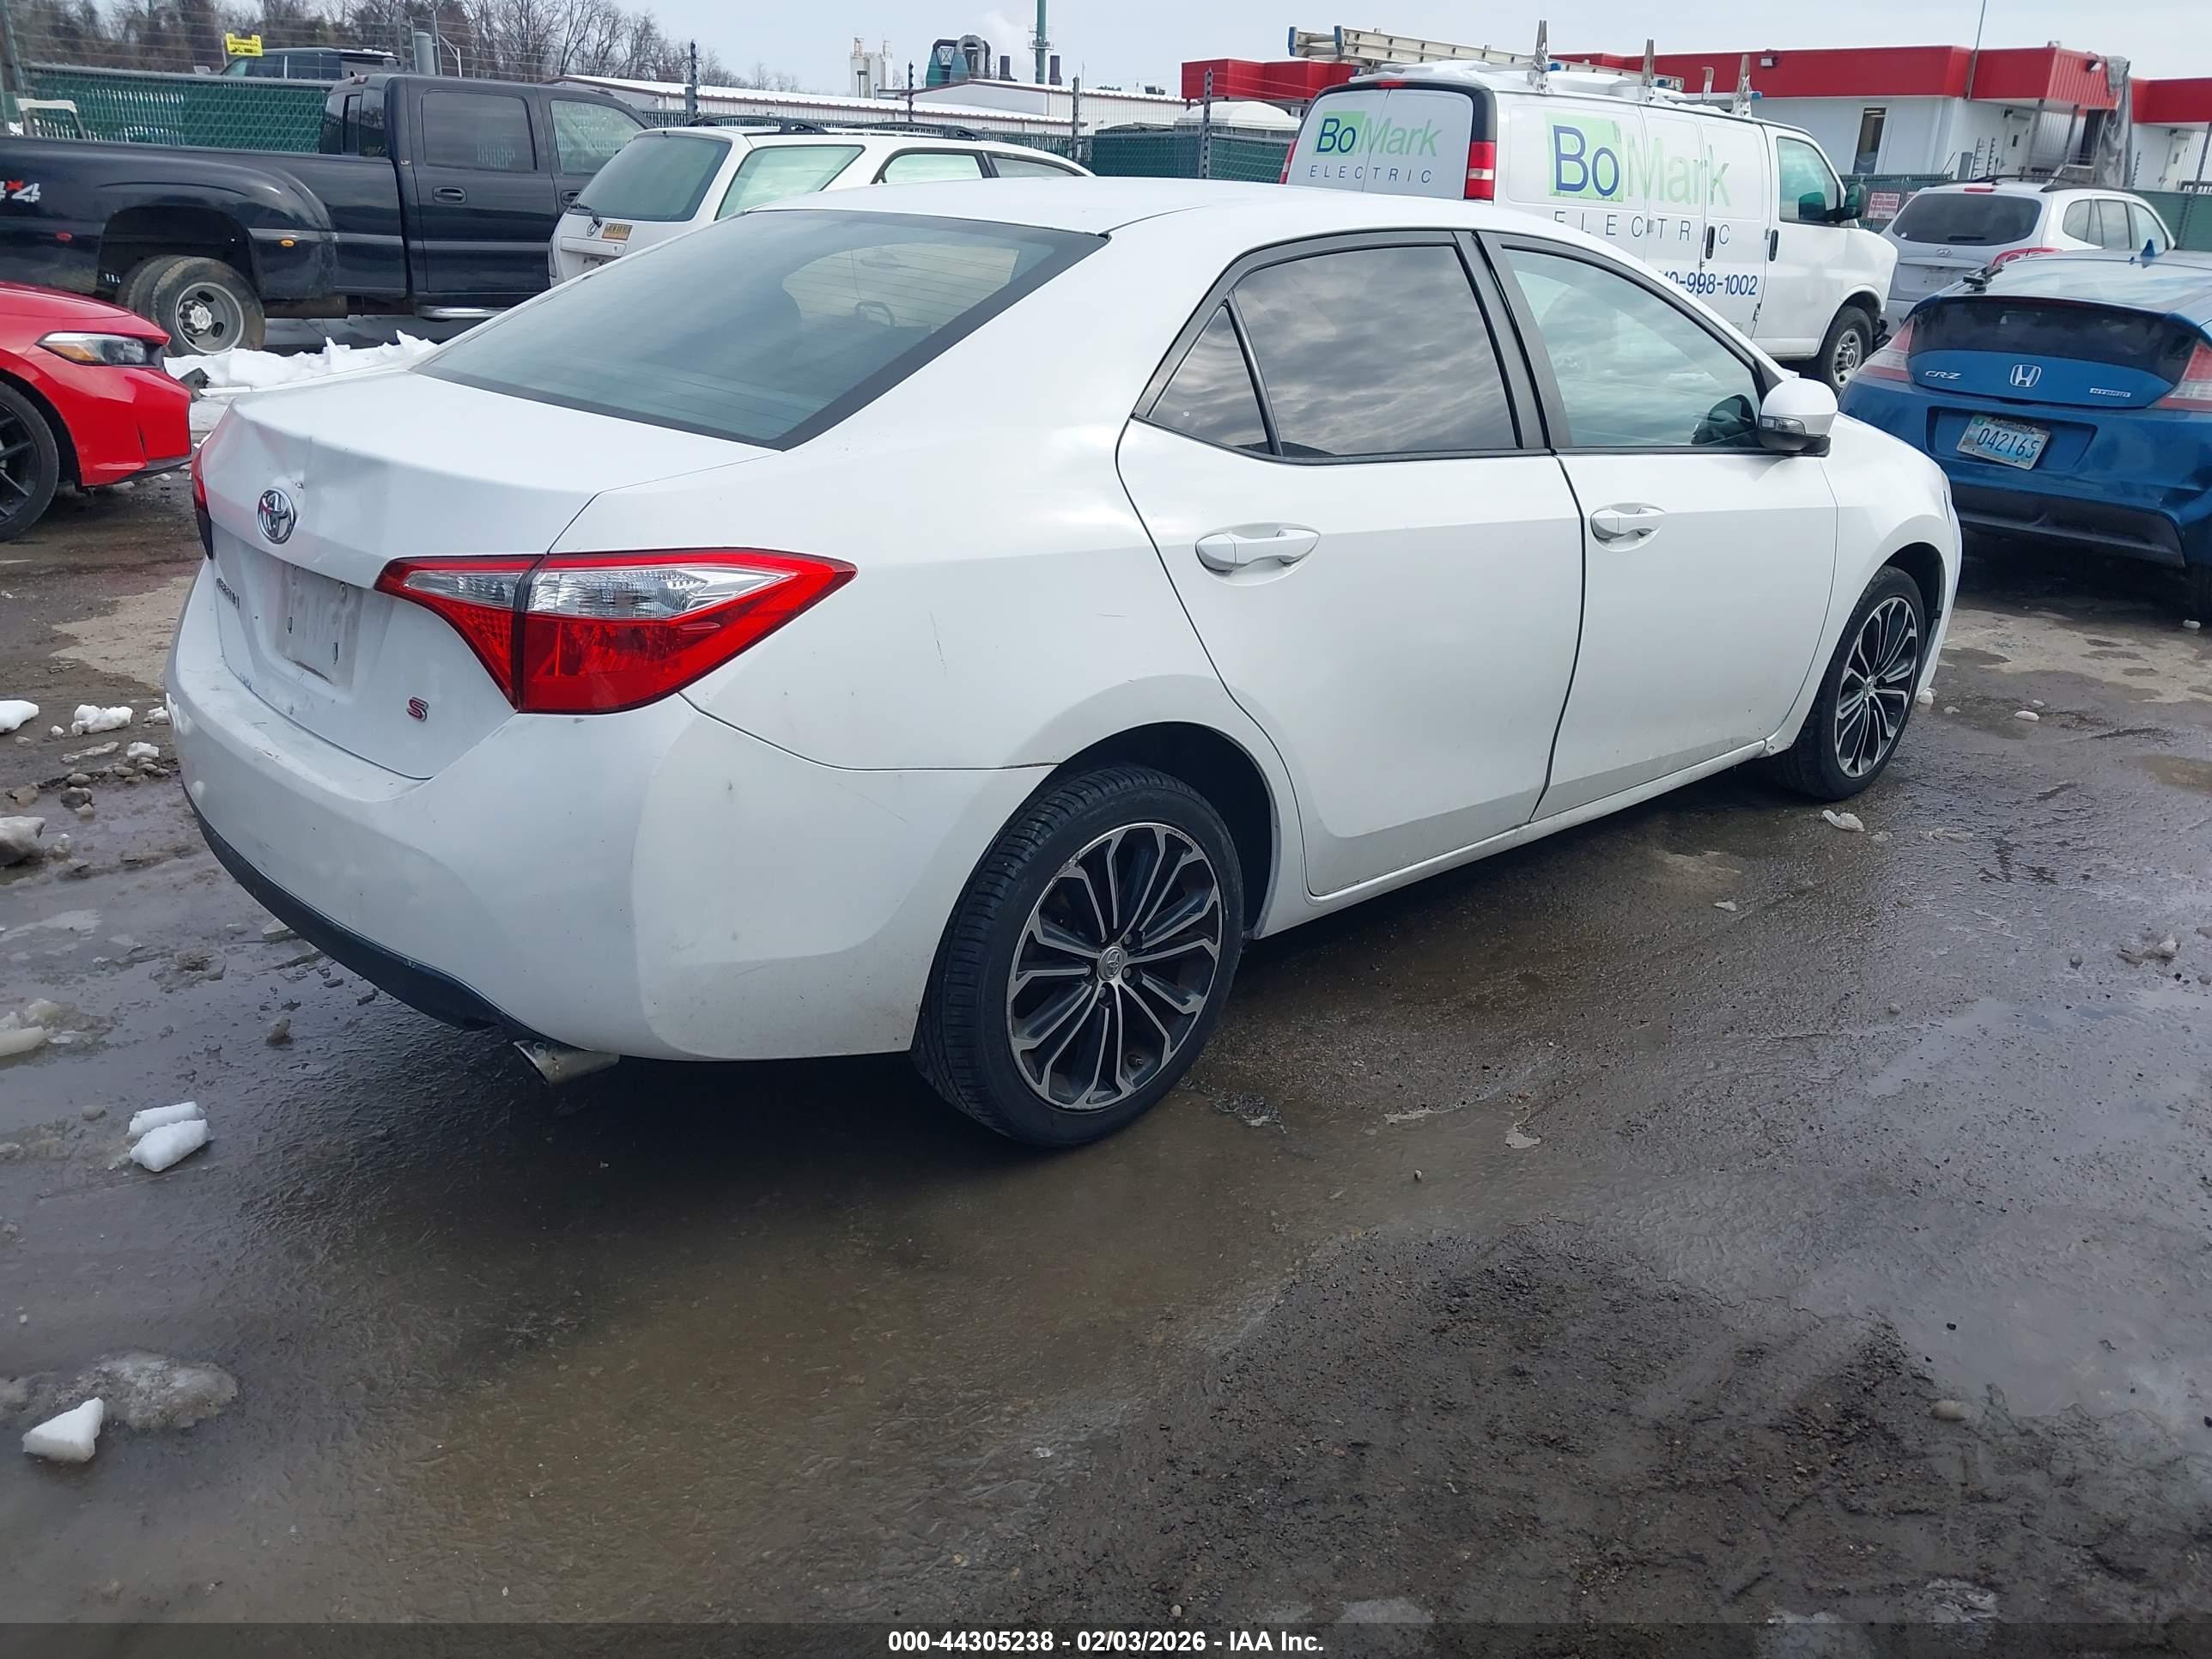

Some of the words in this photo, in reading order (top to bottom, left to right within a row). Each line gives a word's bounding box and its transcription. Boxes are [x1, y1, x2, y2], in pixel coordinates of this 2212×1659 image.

[1316, 117, 1443, 157] BoMark
[1310, 165, 1432, 184] ELECTRIC
[1552, 124, 1732, 207] BoMark
[1553, 210, 1731, 245] ELECTRIC
[406, 696, 428, 722] S
